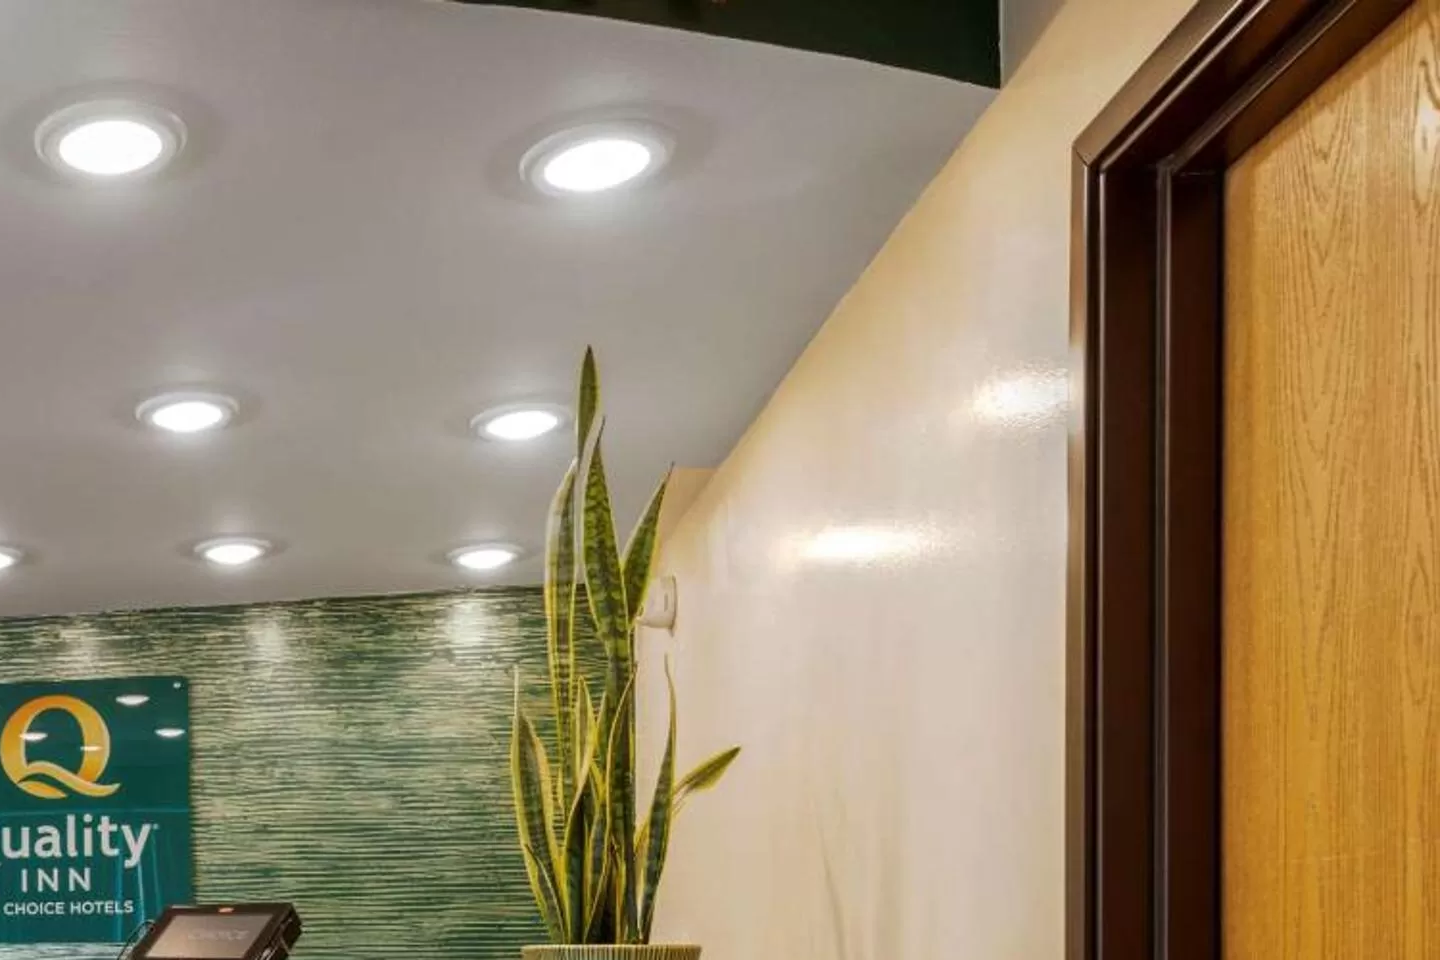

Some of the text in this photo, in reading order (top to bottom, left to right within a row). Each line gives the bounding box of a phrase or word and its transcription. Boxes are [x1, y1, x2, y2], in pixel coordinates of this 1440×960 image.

[0, 694, 121, 799] Q
[20, 867, 92, 893] INN
[3, 902, 66, 916] CHOICE
[69, 900, 135, 915] HOTELS
